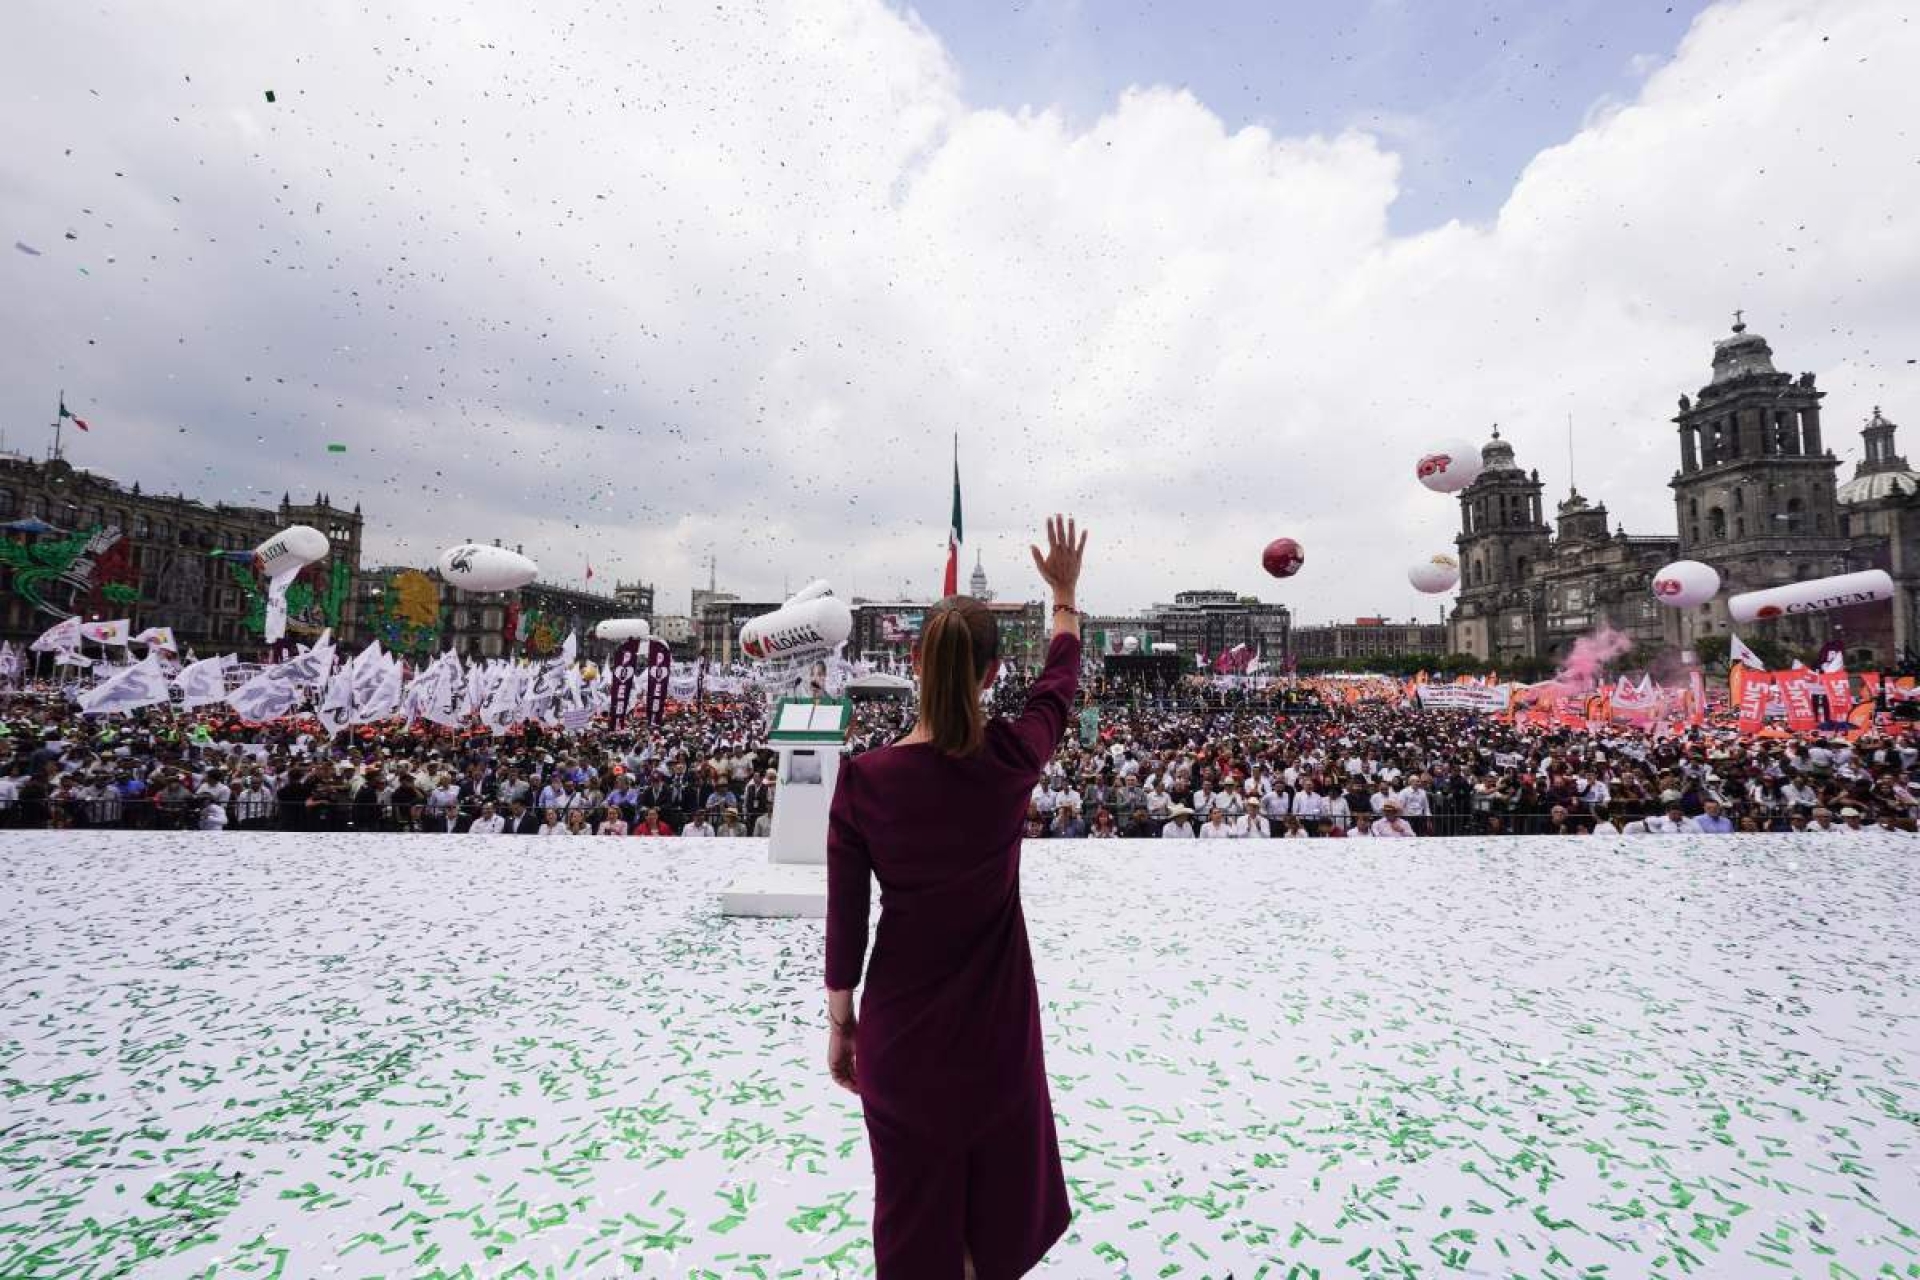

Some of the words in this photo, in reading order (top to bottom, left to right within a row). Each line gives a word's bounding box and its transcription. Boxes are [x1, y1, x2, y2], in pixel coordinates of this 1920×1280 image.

[1786, 591, 1875, 613] CATEM
[764, 631, 824, 653] ALDANA
[1741, 680, 1768, 720] SNTE
[1785, 679, 1813, 720] SNTE
